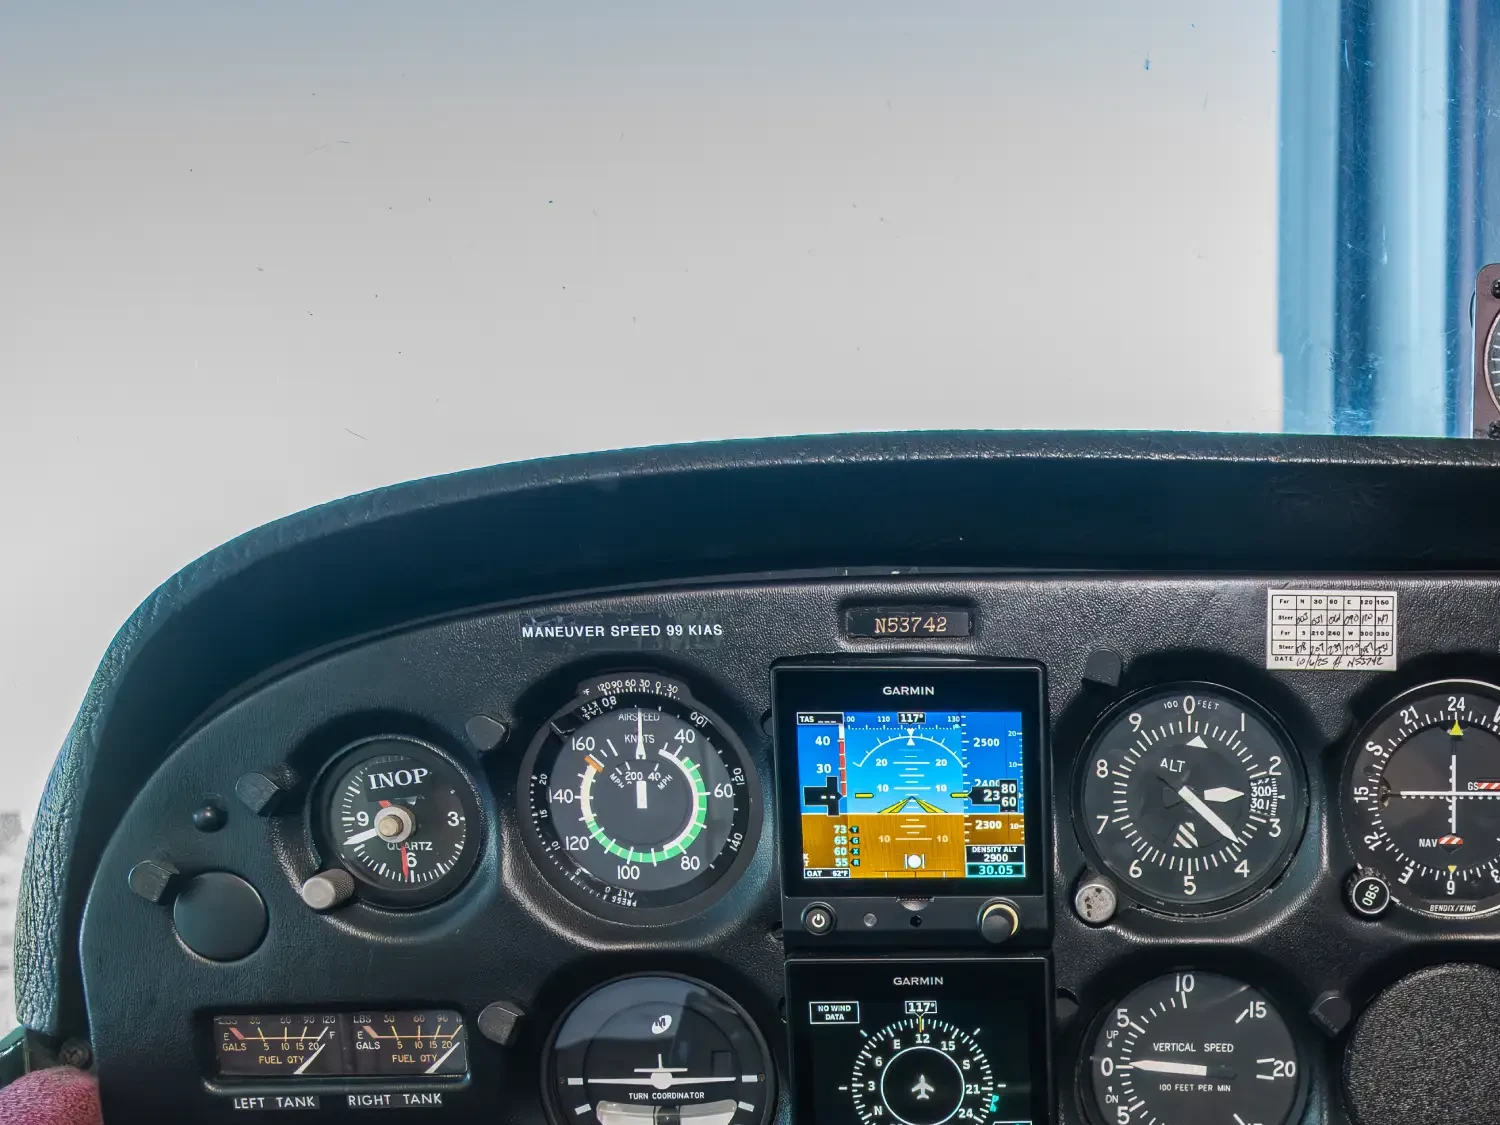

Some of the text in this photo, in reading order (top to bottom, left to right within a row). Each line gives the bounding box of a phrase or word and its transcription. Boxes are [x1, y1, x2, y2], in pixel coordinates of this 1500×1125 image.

[874, 617, 947, 633] N53742
[522, 624, 723, 638] MANEUVER SPEED 99 KIAS
[883, 686, 935, 696] GARMIN
[572, 737, 595, 750] 160
[973, 738, 1000, 747] 2500
[1160, 758, 1185, 773] ALT
[368, 768, 429, 789] INOP
[565, 836, 589, 850] 120
[1419, 839, 1437, 847] NAV
[984, 854, 1008, 862] 2900
[617, 866, 640, 879] 100
[978, 865, 1013, 875] 30.05
[893, 977, 944, 985] GARMIN
[1153, 1043, 1234, 1052] VERTICAL SPEED
[259, 1056, 282, 1064] FUEL
[392, 1054, 416, 1063] FUEL
[234, 1096, 315, 1109] LEFT TANK
[348, 1093, 442, 1106] RIGHT TANK
